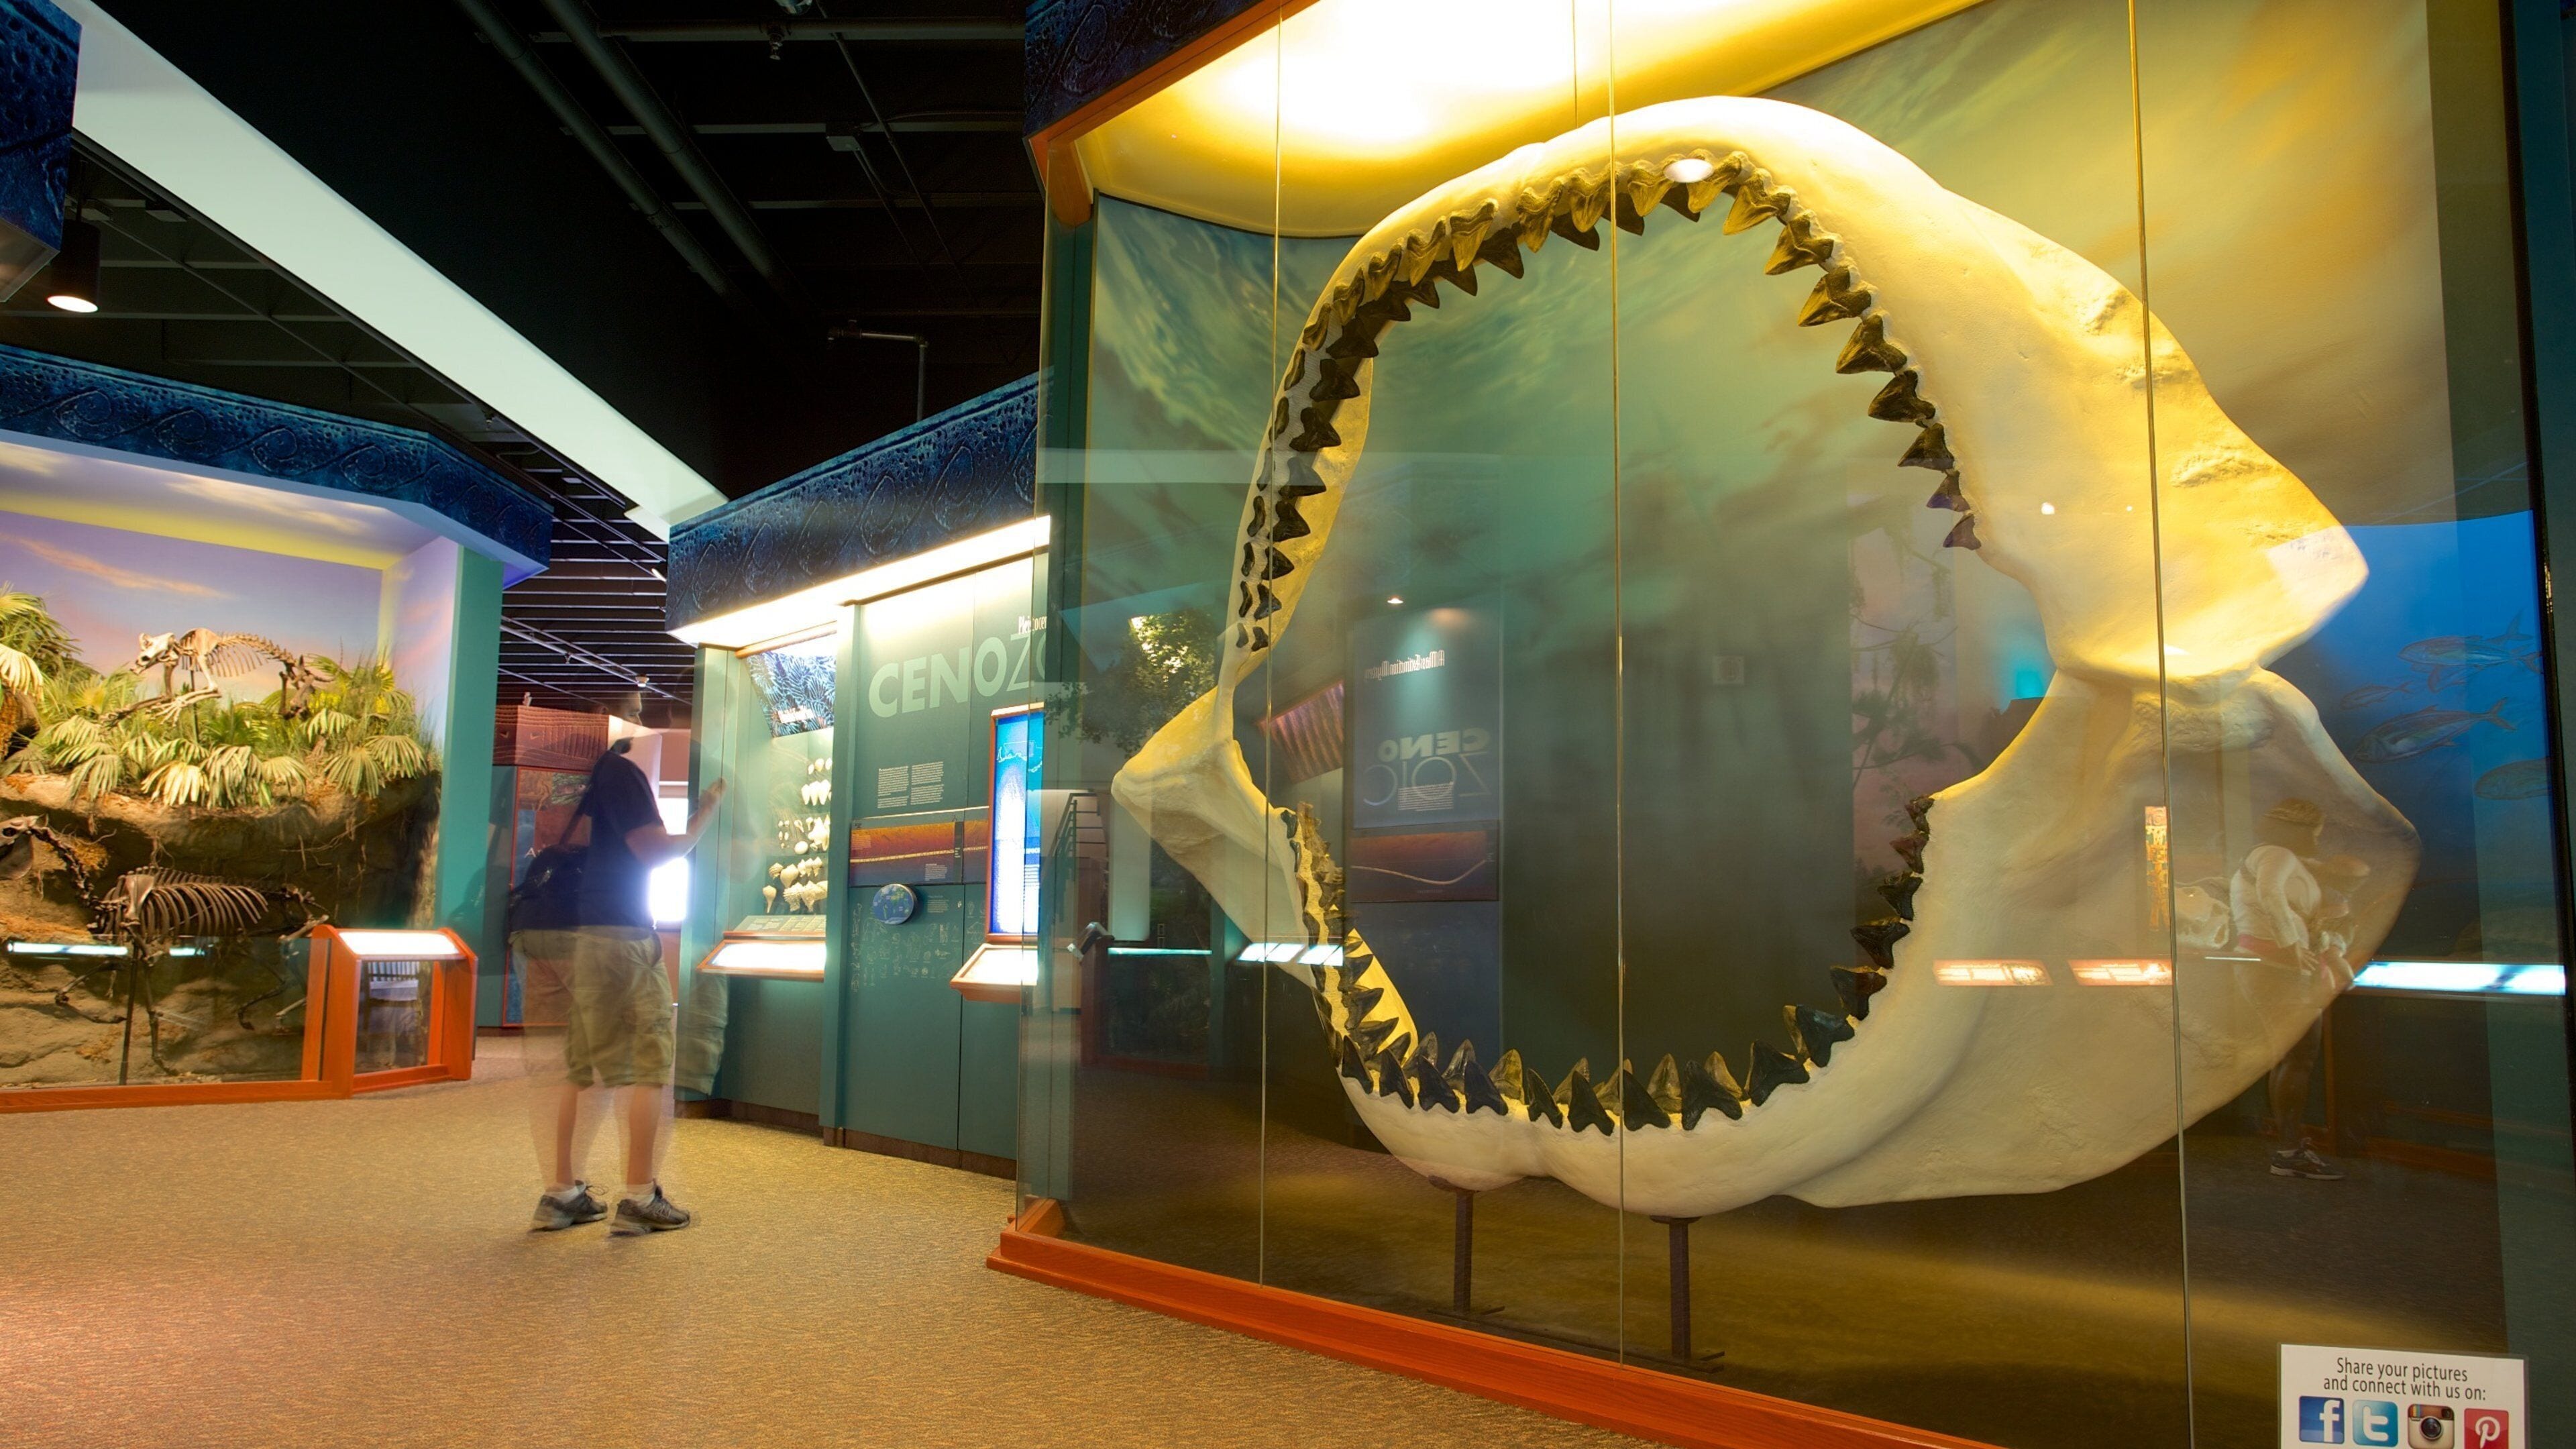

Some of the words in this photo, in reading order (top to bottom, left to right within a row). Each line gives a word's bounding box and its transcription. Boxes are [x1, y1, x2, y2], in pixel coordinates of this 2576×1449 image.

[2337, 1358, 2373, 1375] Share
[2377, 1362, 2408, 1379] your
[2412, 1363, 2468, 1383] pictures
[2324, 1376, 2348, 1391] and
[2353, 1378, 2406, 1395] connect
[2410, 1382, 2440, 1398] with
[2445, 1387, 2461, 1400] us
[2465, 1388, 2486, 1401] on:
